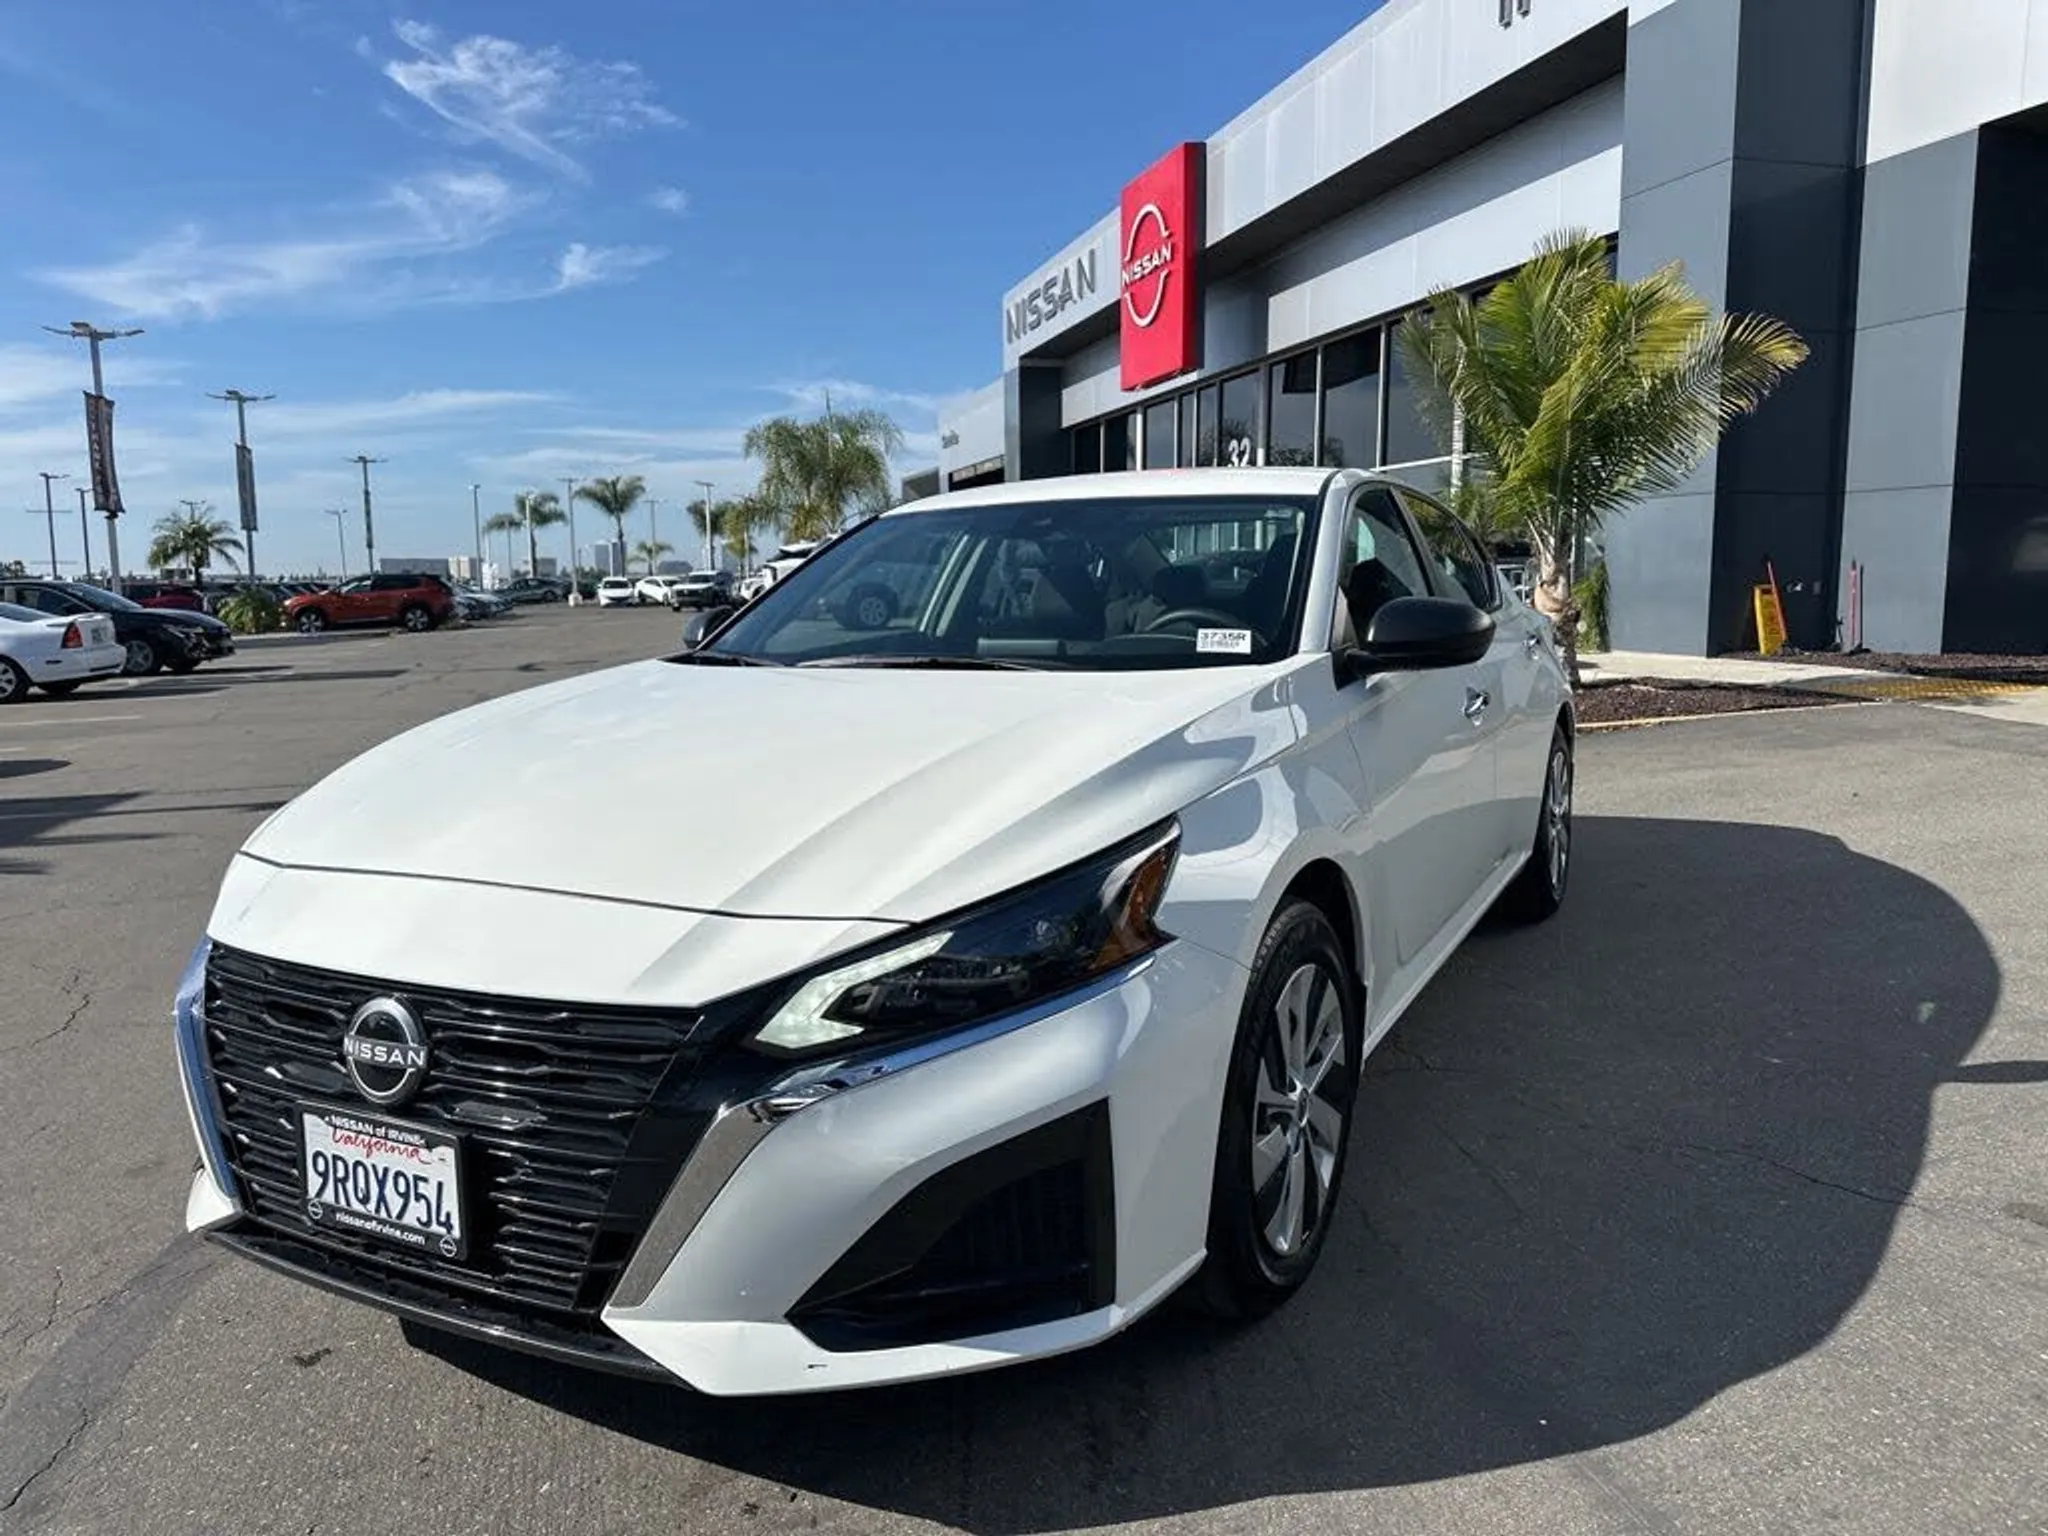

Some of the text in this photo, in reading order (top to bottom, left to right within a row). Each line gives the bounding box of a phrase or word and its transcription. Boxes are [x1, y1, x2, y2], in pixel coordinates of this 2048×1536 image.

[1122, 243, 1171, 286] NISSAN
[1006, 249, 1096, 343] NISSAN
[343, 1036, 425, 1067] NISSAN
[331, 1114, 374, 1135] NISSAN
[312, 1150, 453, 1235] 9RQX954
